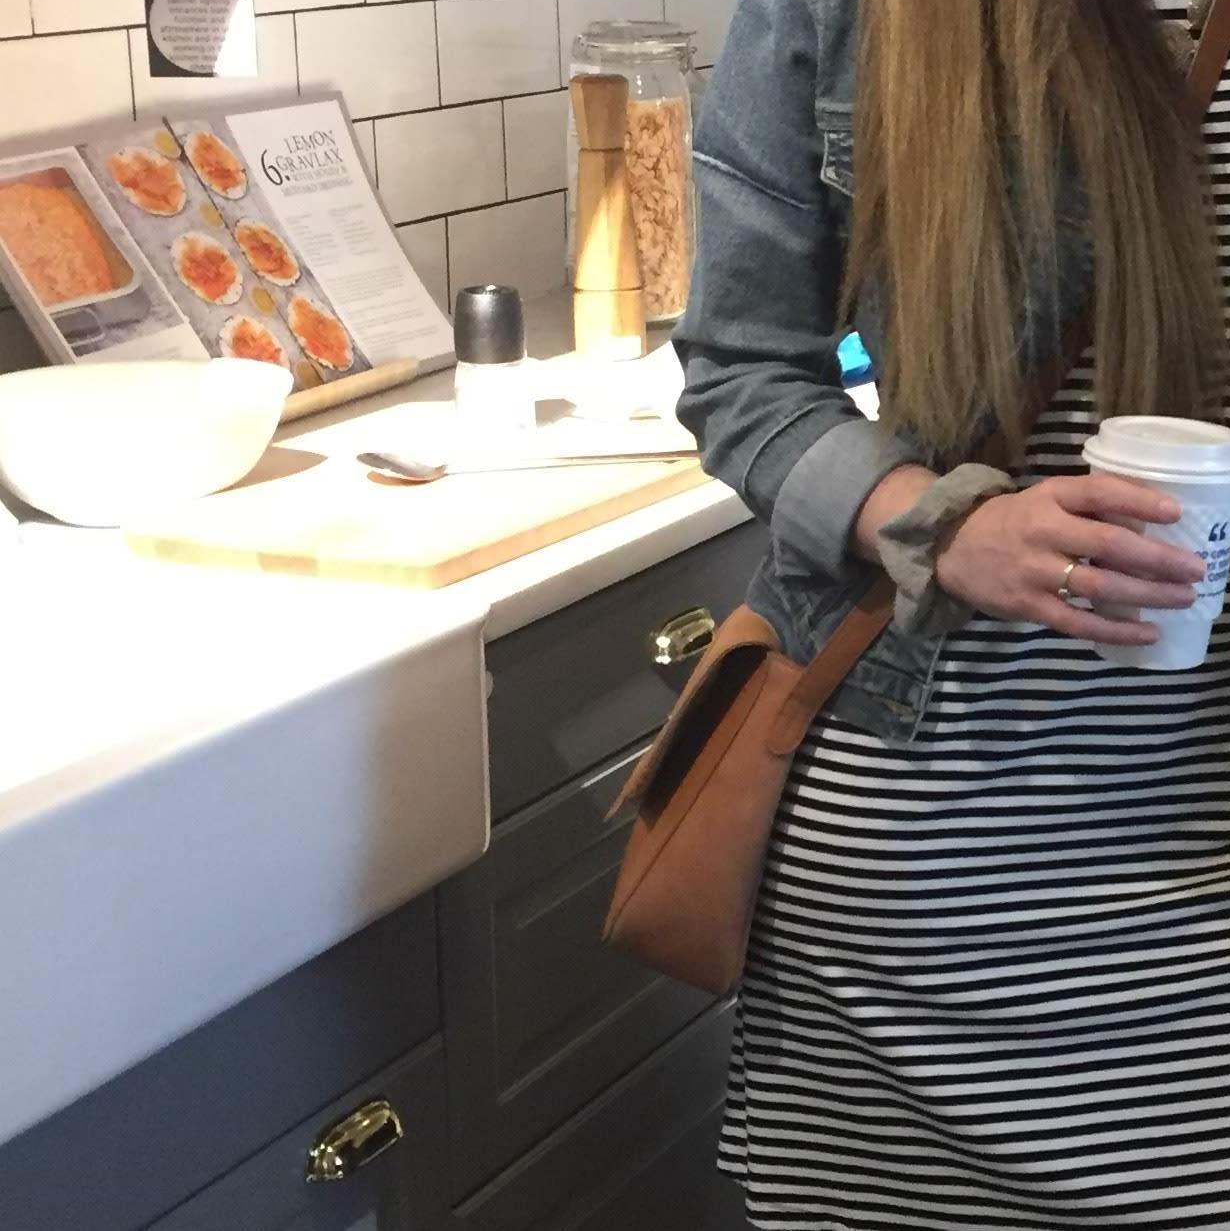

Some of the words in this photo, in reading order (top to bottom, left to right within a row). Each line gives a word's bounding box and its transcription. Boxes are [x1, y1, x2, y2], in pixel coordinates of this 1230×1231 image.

[284, 130, 336, 153] LEMON
[261, 149, 291, 185] 6.
[275, 149, 343, 172] GRAVLAX
